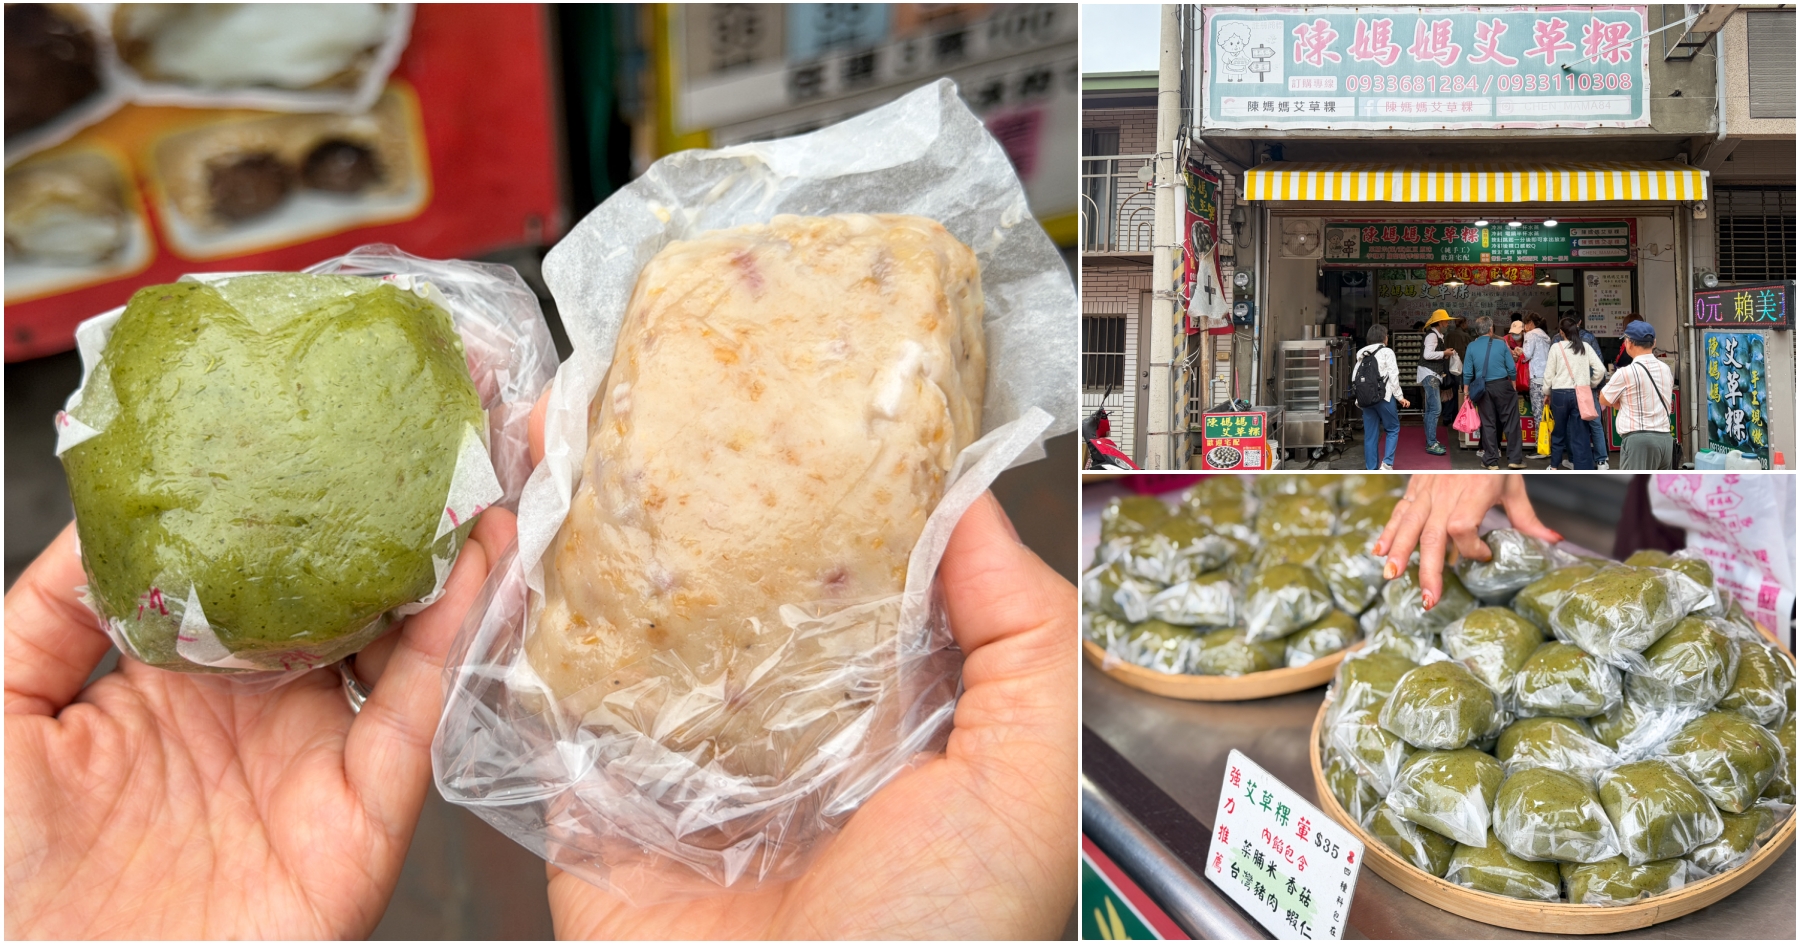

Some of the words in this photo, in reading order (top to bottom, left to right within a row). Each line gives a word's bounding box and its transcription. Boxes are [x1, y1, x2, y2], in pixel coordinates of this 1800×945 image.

[1292, 17, 1633, 67] 陳媽媽艾草粿
[1247, 100, 1336, 113] 陳媽媽艾草粿
[1291, 79, 1334, 89] 訂購專線
[1385, 100, 1473, 113] 陳媽媽艾草粿
[1362, 226, 1479, 244] 陳媽媽艾草粿
[1708, 337, 1721, 402] 陳媽媽
[1723, 338, 1746, 440] 艾草粿
[1207, 417, 1248, 427] 陳媽媽
[1221, 427, 1260, 437] 艾草粿
[1212, 766, 1241, 873] 強力推薦
[1244, 779, 1291, 827] 艾草粿
[1295, 816, 1311, 842] 葷
[1315, 832, 1340, 859] $35
[1241, 839, 1277, 880] 菜脯米
[1285, 877, 1311, 908] 香菇
[1230, 862, 1279, 913] 台灣豬肉
[1286, 909, 1312, 940] 蝦仁
